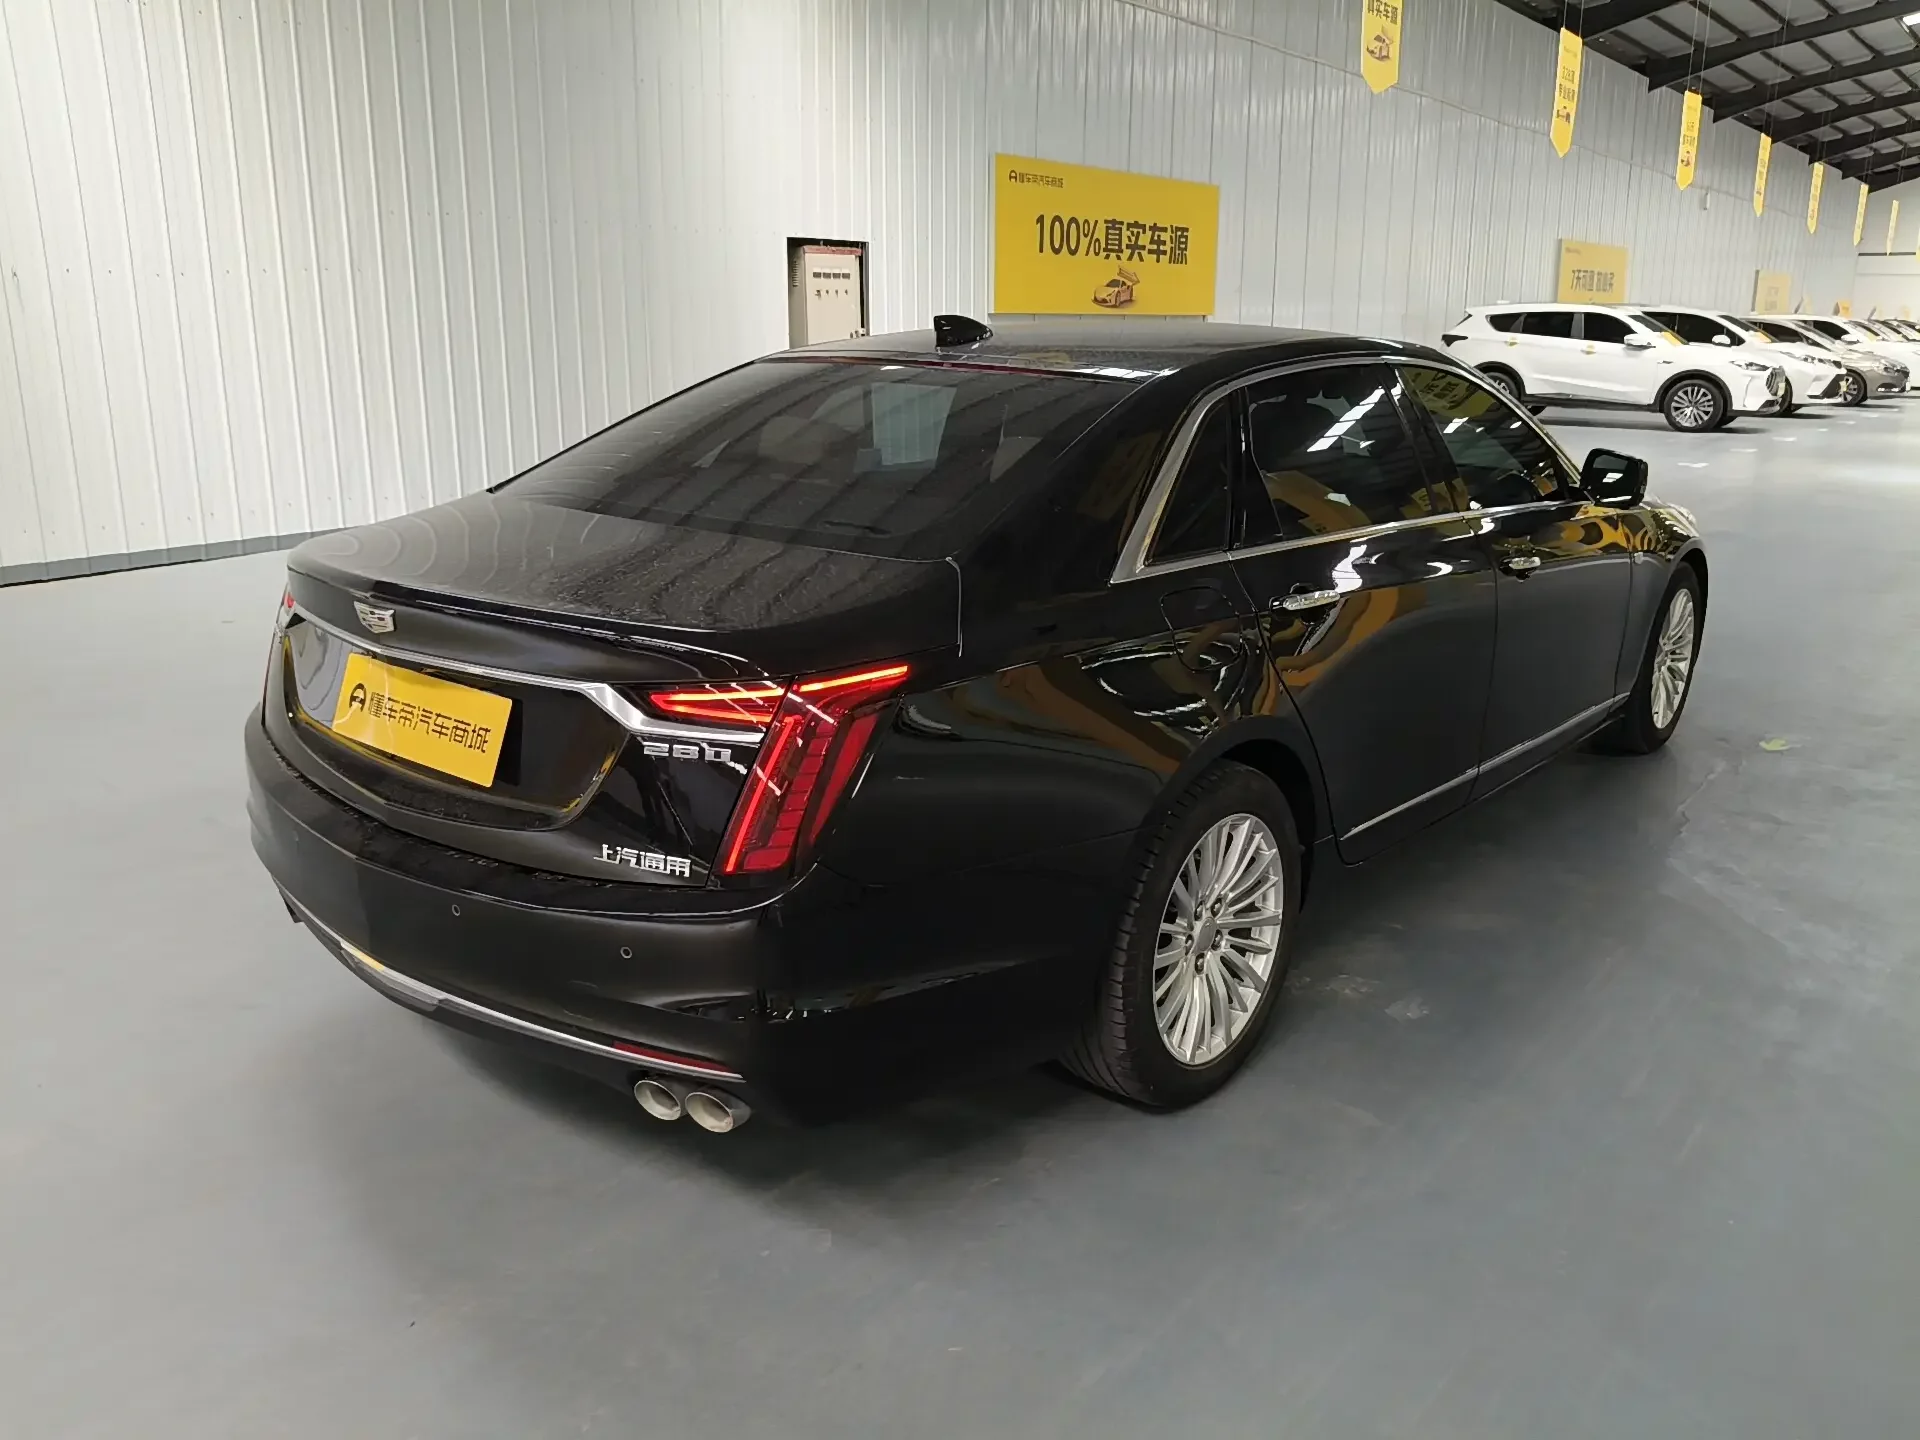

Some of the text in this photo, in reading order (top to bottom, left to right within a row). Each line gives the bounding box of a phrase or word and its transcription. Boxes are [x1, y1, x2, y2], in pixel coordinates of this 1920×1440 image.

[1035, 213, 1190, 265] 100%真实车源
[367, 691, 492, 754] 懂车帝汽车商城
[593, 843, 692, 878] 上汽通用
